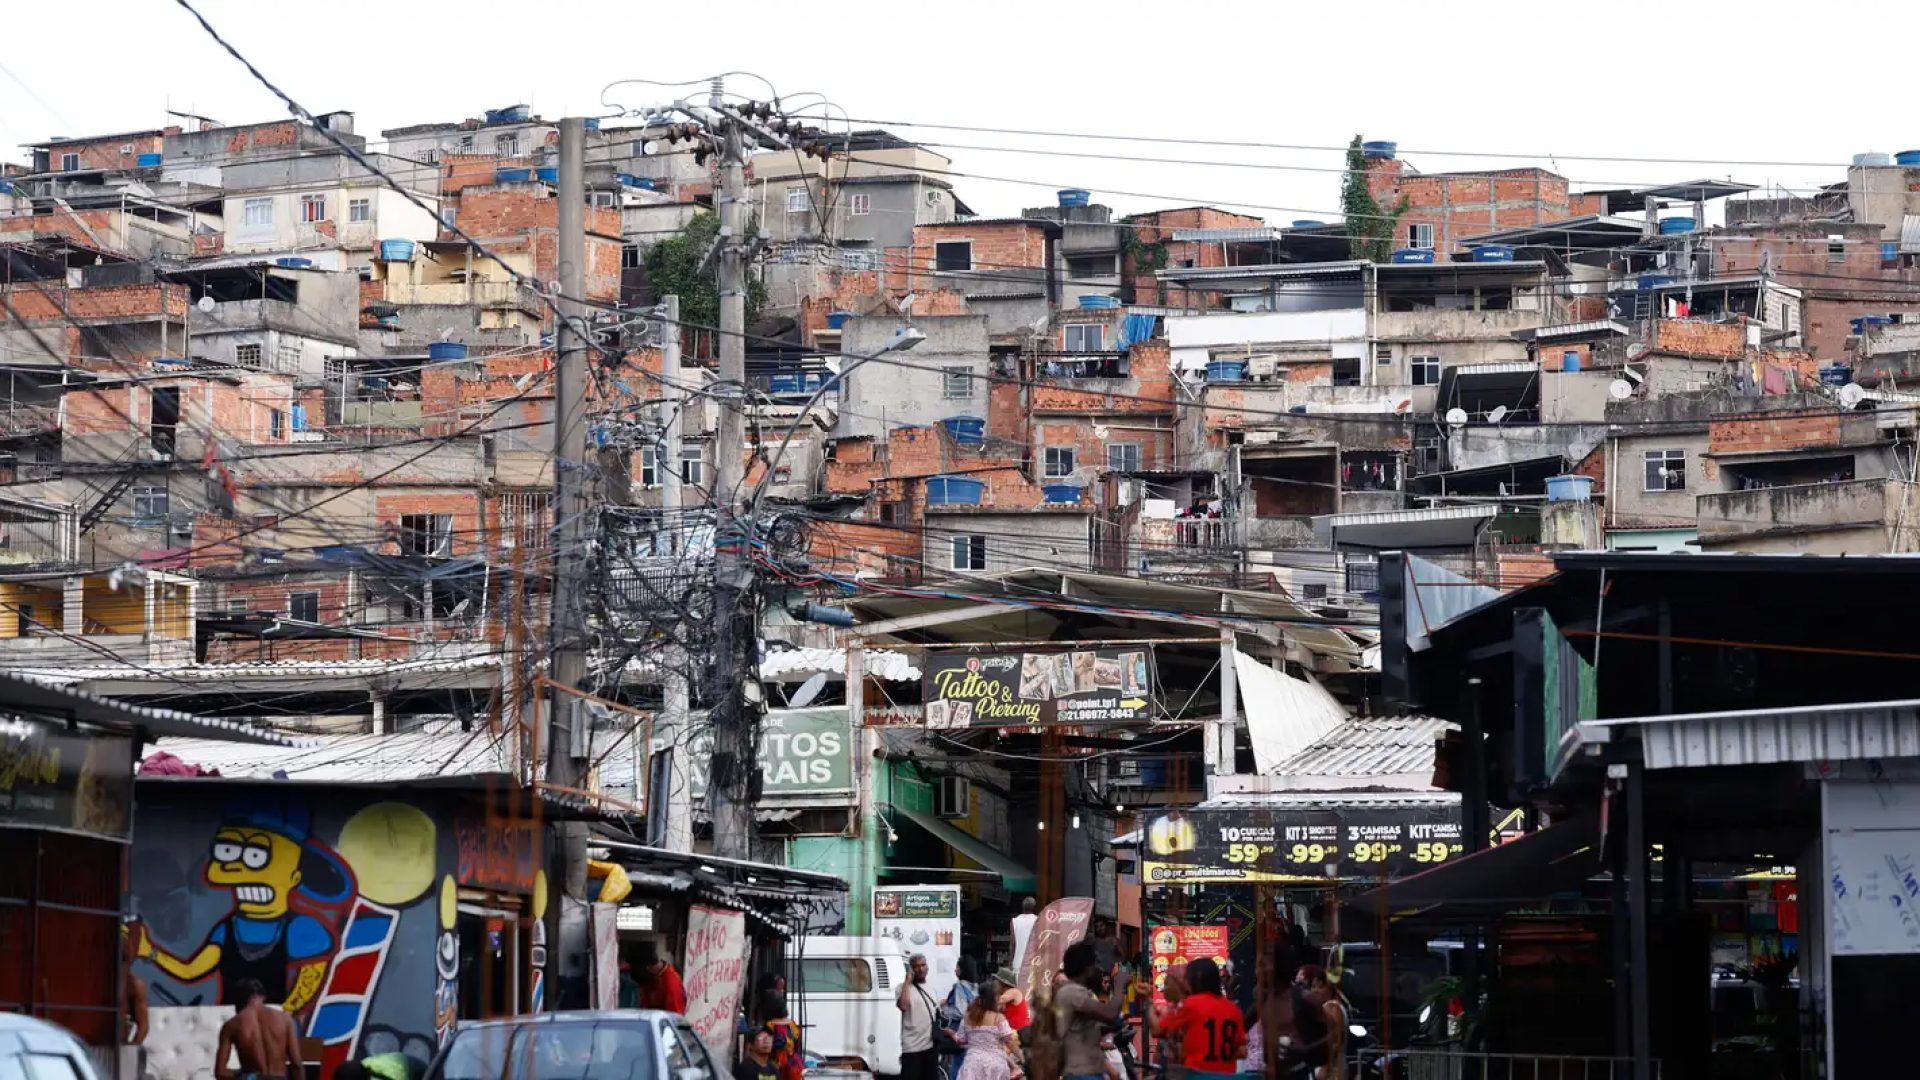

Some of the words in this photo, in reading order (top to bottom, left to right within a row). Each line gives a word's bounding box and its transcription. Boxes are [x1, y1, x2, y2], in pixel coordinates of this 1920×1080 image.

[934, 668, 999, 700] Tattoo
[1001, 688, 1012, 702] &
[975, 696, 1040, 724] Piercing
[1220, 826, 1239, 842] 10
[1286, 826, 1300, 841] KIT
[1302, 826, 1308, 841] 3
[1348, 825, 1359, 841] 3
[1360, 825, 1401, 835] CAMISAS
[1409, 824, 1431, 839] KIT
[1432, 824, 1457, 832] CAMISA
[1203, 1016, 1237, 1061] 18
